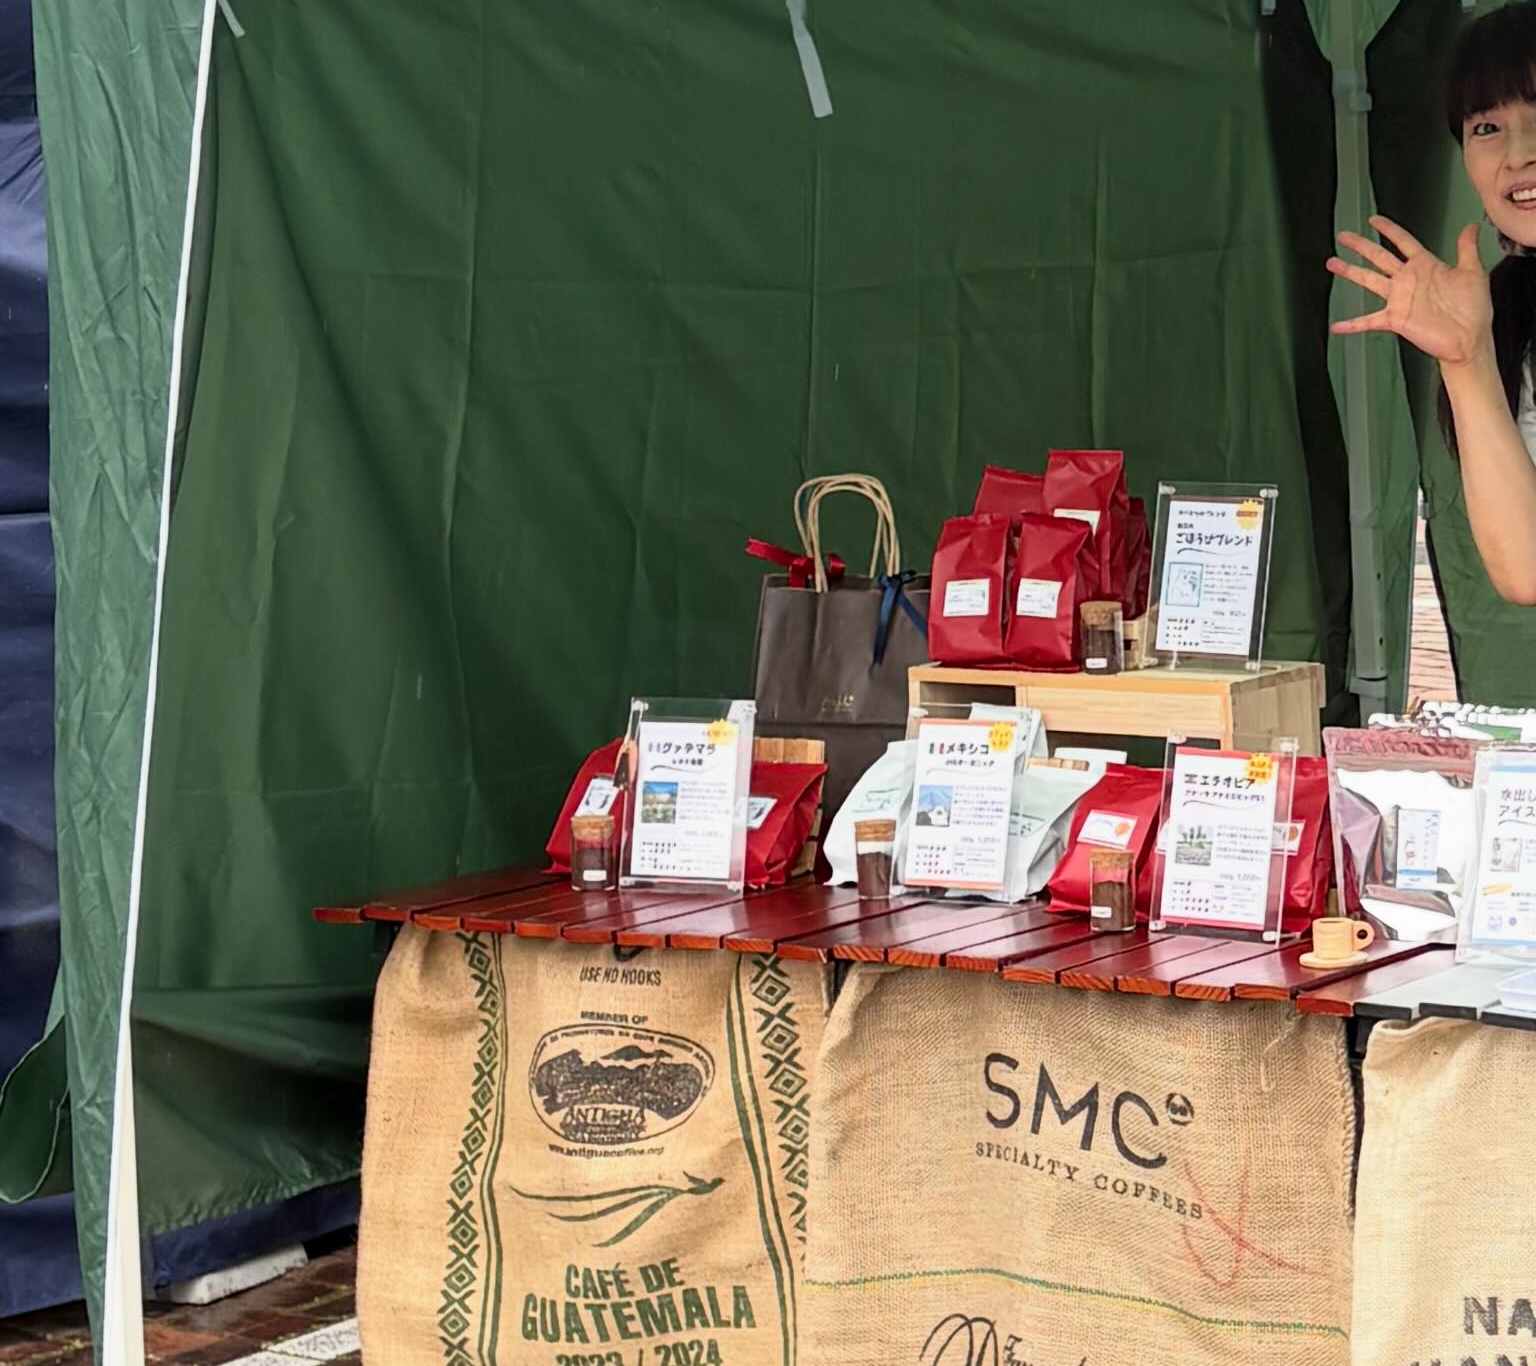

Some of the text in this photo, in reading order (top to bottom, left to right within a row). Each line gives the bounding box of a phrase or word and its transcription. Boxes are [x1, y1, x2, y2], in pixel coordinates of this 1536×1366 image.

[946, 742, 990, 755] メキシコ
[1200, 775, 1256, 789] エチオピア
[580, 966, 662, 986] USE NO HOOKS
[632, 1014, 648, 1025] OF
[984, 1052, 1167, 1169] SMC
[975, 1141, 1203, 1220] SPECIALTY COFFEES
[565, 1257, 685, 1300] CAFÉ DE
[521, 1285, 757, 1344] GUATEMALA
